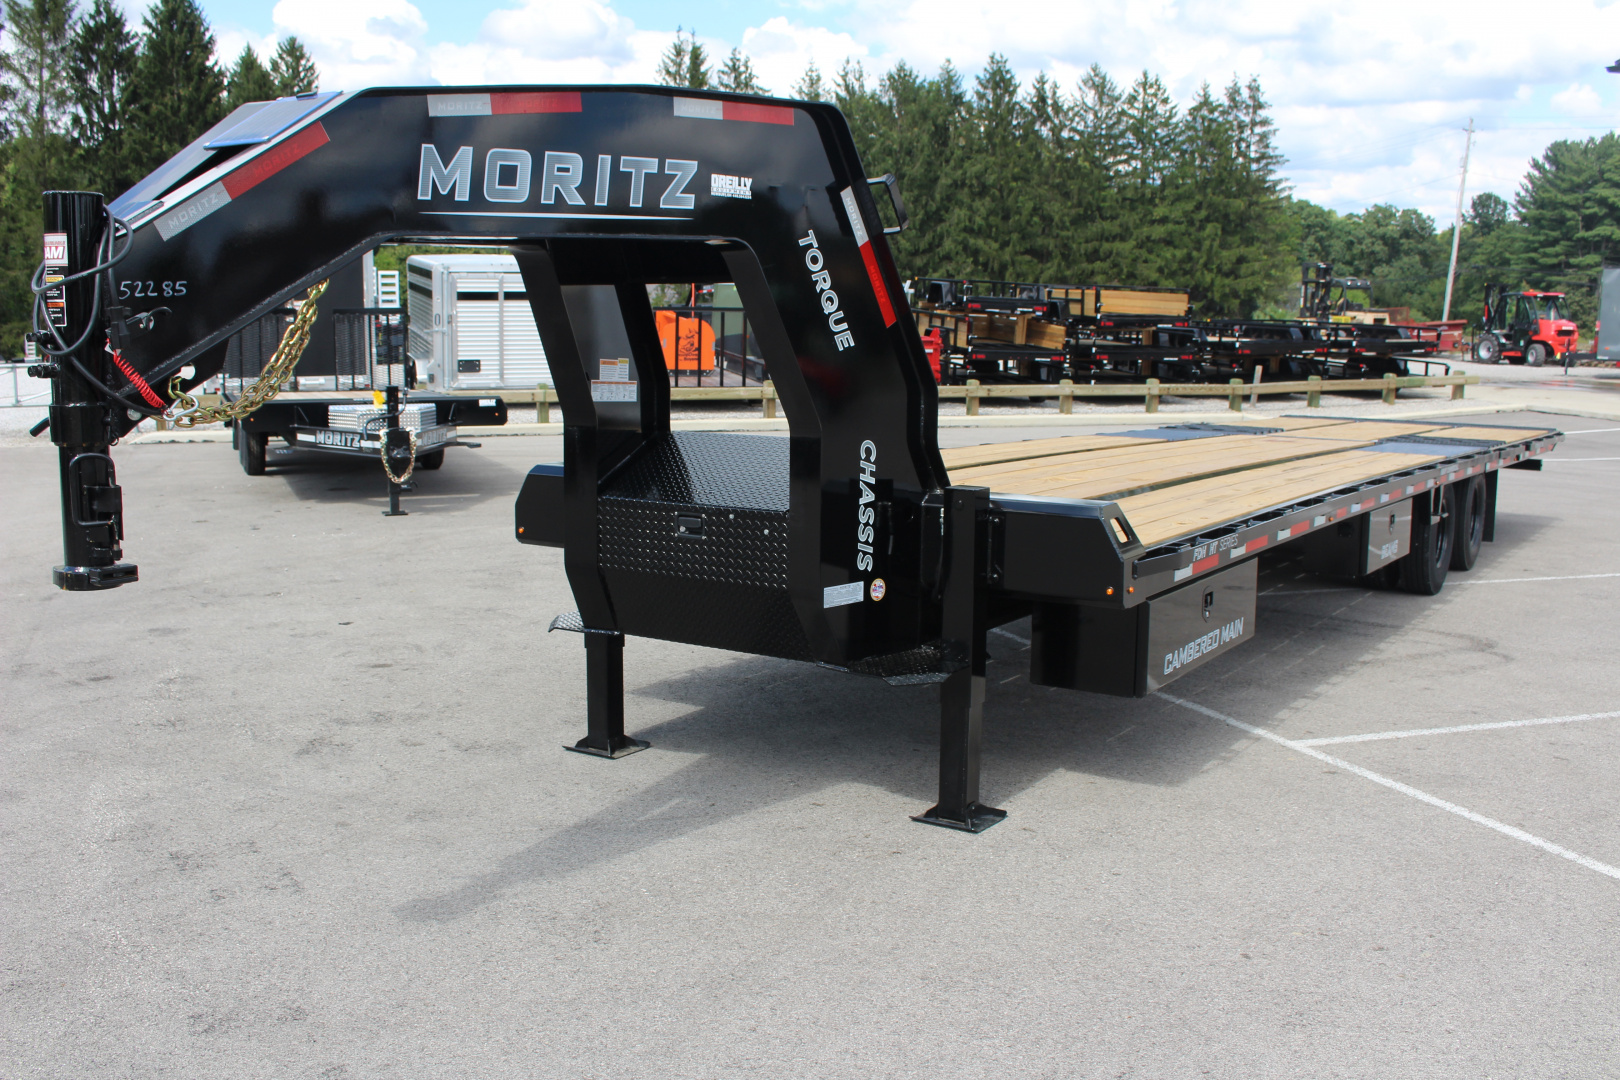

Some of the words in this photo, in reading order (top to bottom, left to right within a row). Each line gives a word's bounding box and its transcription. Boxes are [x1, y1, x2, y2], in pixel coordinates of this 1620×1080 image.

[437, 101, 483, 111] MORITZ
[254, 143, 299, 177] MORITZ
[417, 143, 698, 210] MORITZ
[168, 193, 219, 229] MORITZ
[846, 197, 863, 236] MORITZ
[798, 229, 855, 352] TORQUE
[869, 265, 886, 302] MORITZ
[316, 430, 360, 448] MORITZ
[856, 439, 877, 572] CHASSIS
[1219, 534, 1239, 551] SERIES
[1164, 628, 1220, 675] CAMBERED
[1220, 617, 1244, 645] MAIN
